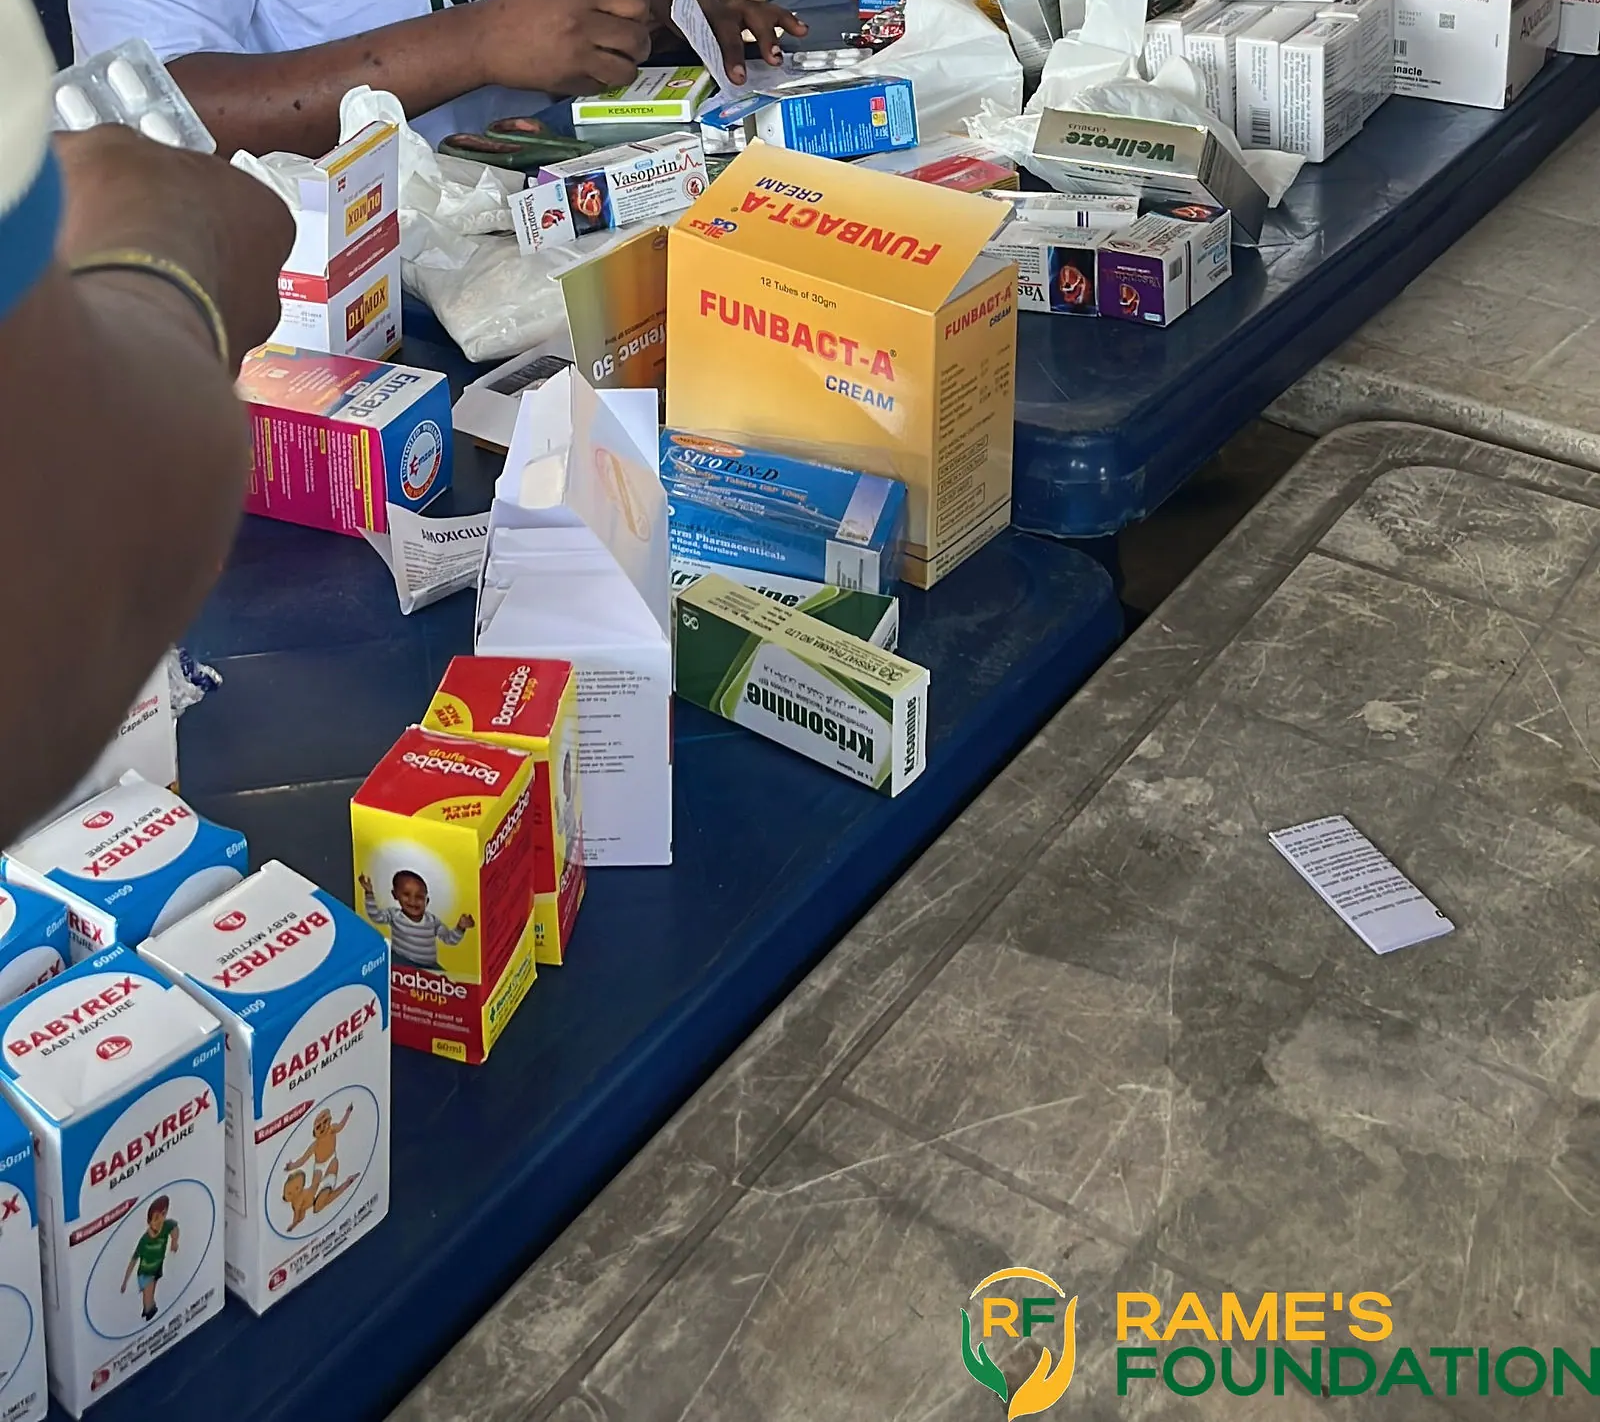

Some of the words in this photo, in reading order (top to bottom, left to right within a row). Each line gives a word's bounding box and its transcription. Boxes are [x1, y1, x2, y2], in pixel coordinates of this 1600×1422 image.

[607, 106, 655, 116] KESARTEM
[1065, 131, 1175, 162] Wellroze
[611, 159, 678, 187] Vasoprin
[755, 176, 823, 203] CREAM
[348, 192, 381, 227] OLIMOX
[740, 190, 943, 266] FUNBACT-A
[348, 285, 386, 331] OLIMOX
[760, 276, 772, 287] 12
[774, 280, 800, 298] Tubes
[801, 290, 811, 301] of
[811, 293, 838, 310] 30gm
[944, 284, 1012, 340] FUNBACT-A
[700, 289, 895, 382] FUNBACT-A
[592, 353, 615, 382] 50
[348, 373, 421, 418] Emcap
[825, 375, 895, 412] CREAM
[421, 525, 488, 544] AMOXICILLI
[696, 532, 786, 562] Pharmaceuticals
[747, 681, 875, 765] Krisomine
[903, 696, 918, 777] Krisomine
[403, 752, 500, 786] Bonababe
[428, 748, 466, 763] syrup
[133, 807, 162, 830] BABY
[444, 809, 482, 821] NEW
[484, 786, 531, 866] Bonababe
[84, 806, 191, 877] BABYREX
[85, 821, 133, 859] MIXTURE
[104, 884, 133, 905] 60ml
[270, 911, 298, 936] BABY
[94, 945, 125, 970] 60ml
[212, 910, 333, 989] BABYREX
[216, 926, 270, 966] MIXTURE
[361, 952, 386, 978] 60ml
[392, 971, 468, 1002] nababe
[410, 988, 448, 1007] syrup
[7, 975, 143, 1059] BABYREX
[40, 1030, 78, 1058] BABY
[78, 999, 136, 1038] MIXTURE
[192, 1042, 222, 1069] 60ml
[271, 997, 379, 1088] BABYREX
[436, 1042, 462, 1054] 60ml
[288, 1063, 320, 1092] BABY
[320, 1030, 366, 1072] MIXTURE
[89, 1089, 212, 1188] BABYREX
[109, 1160, 144, 1191] BABY
[144, 1126, 196, 1166] MIXTURE
